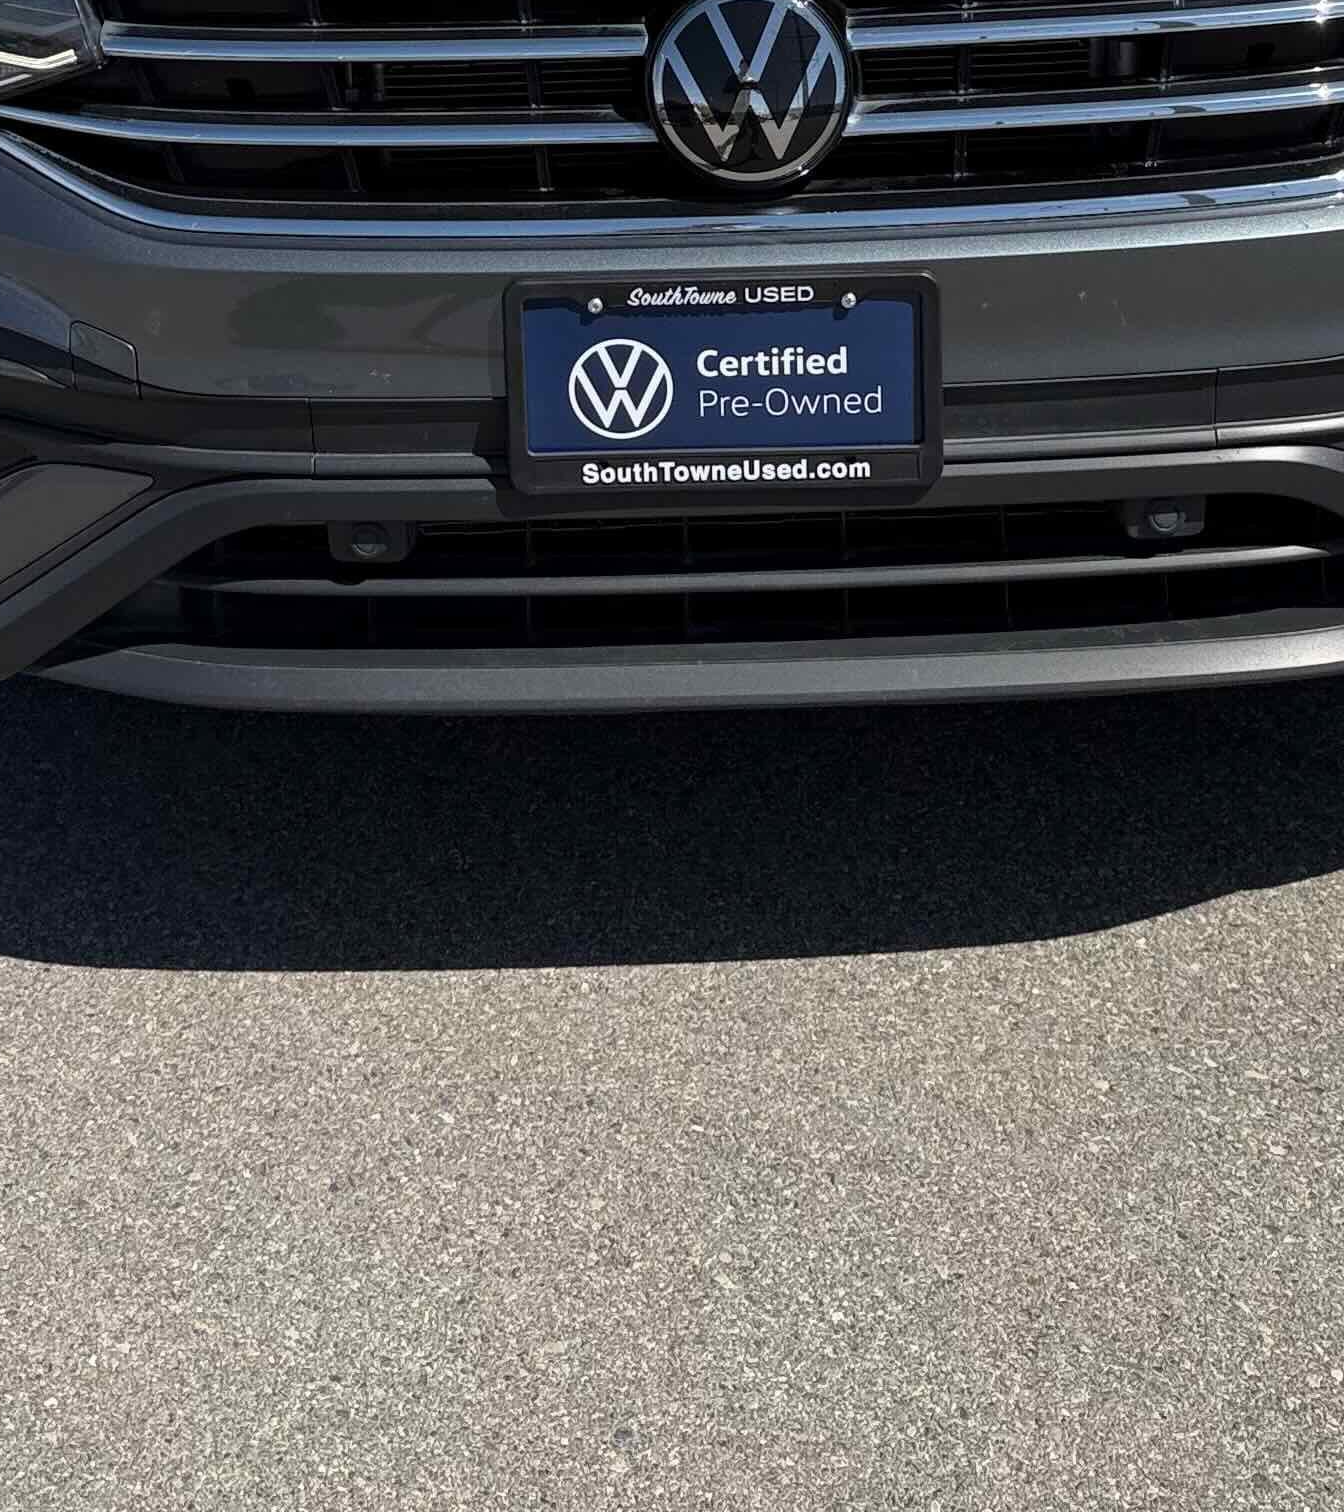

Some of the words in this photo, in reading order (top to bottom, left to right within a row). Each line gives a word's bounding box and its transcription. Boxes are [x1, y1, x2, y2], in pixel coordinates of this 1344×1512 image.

[627, 287, 736, 307] SouthTowne
[745, 286, 814, 303] USED
[696, 346, 848, 377] Certified
[698, 386, 883, 417] Pre-Owned
[581, 458, 872, 486] SouthTowneUsed.com
